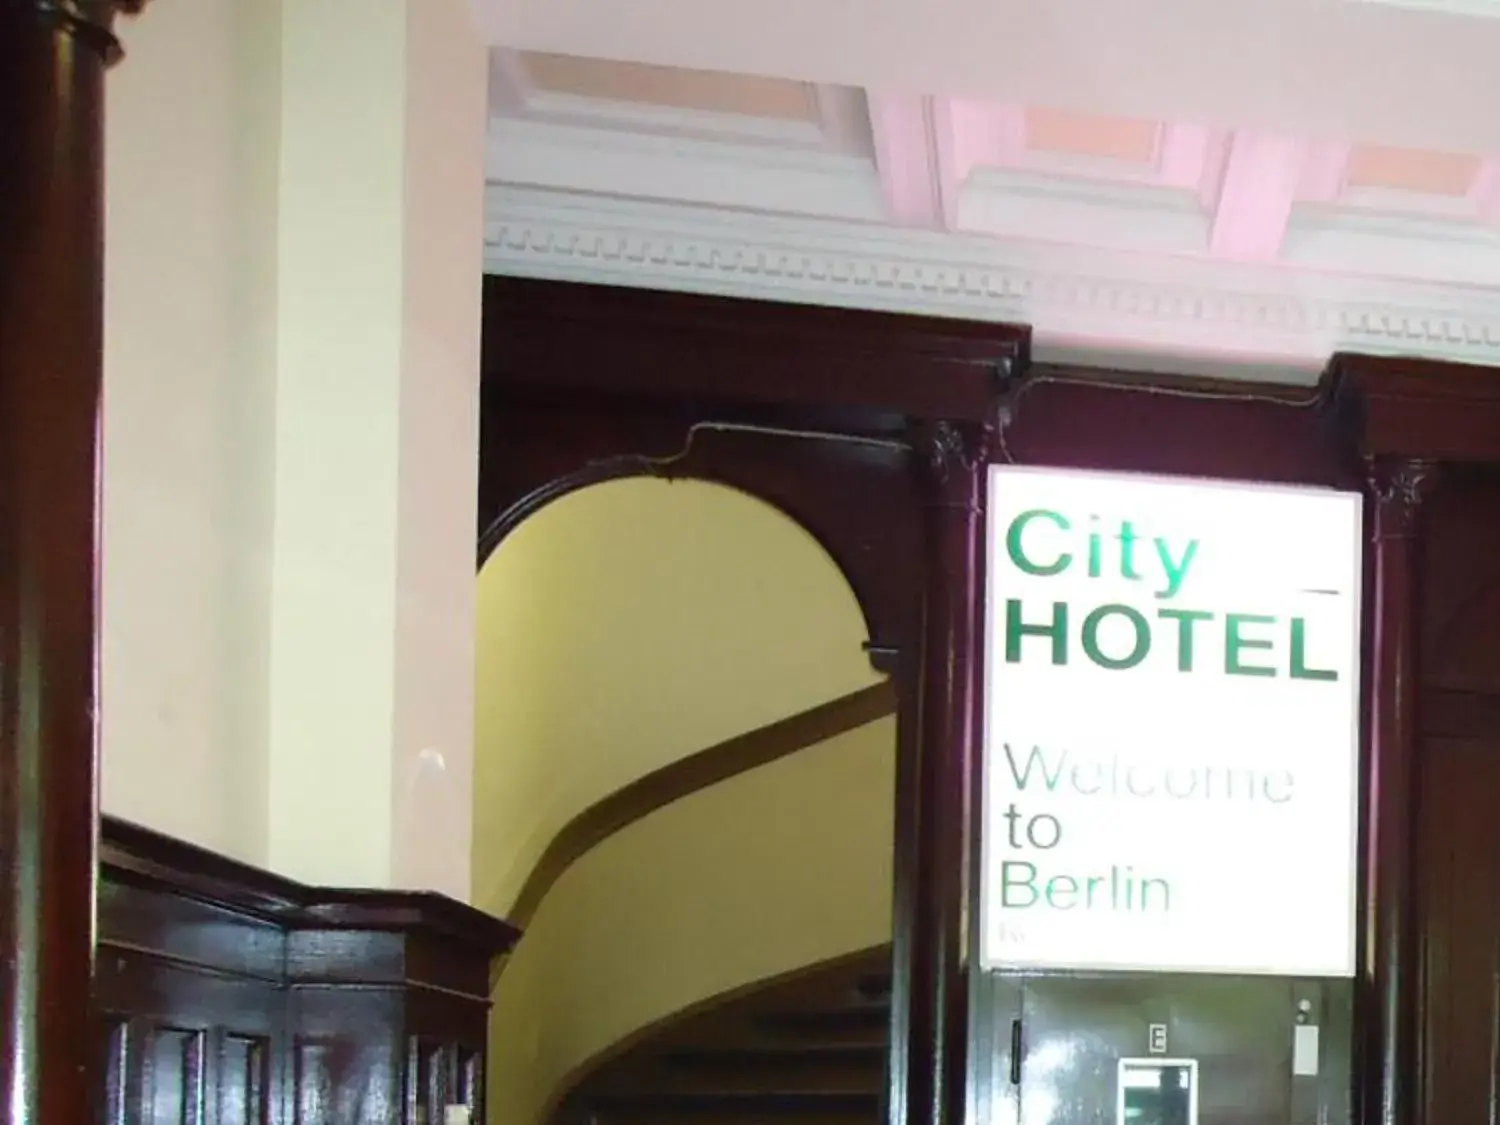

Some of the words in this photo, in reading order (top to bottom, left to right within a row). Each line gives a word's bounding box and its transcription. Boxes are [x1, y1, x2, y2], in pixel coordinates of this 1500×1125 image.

[1004, 507, 1200, 599] City
[1004, 598, 1340, 682] HOTEL
[1002, 742, 1296, 804] Welcome
[1002, 803, 1063, 850] to
[1000, 860, 1171, 912] Berlin
[1152, 1027, 1164, 1049] E
